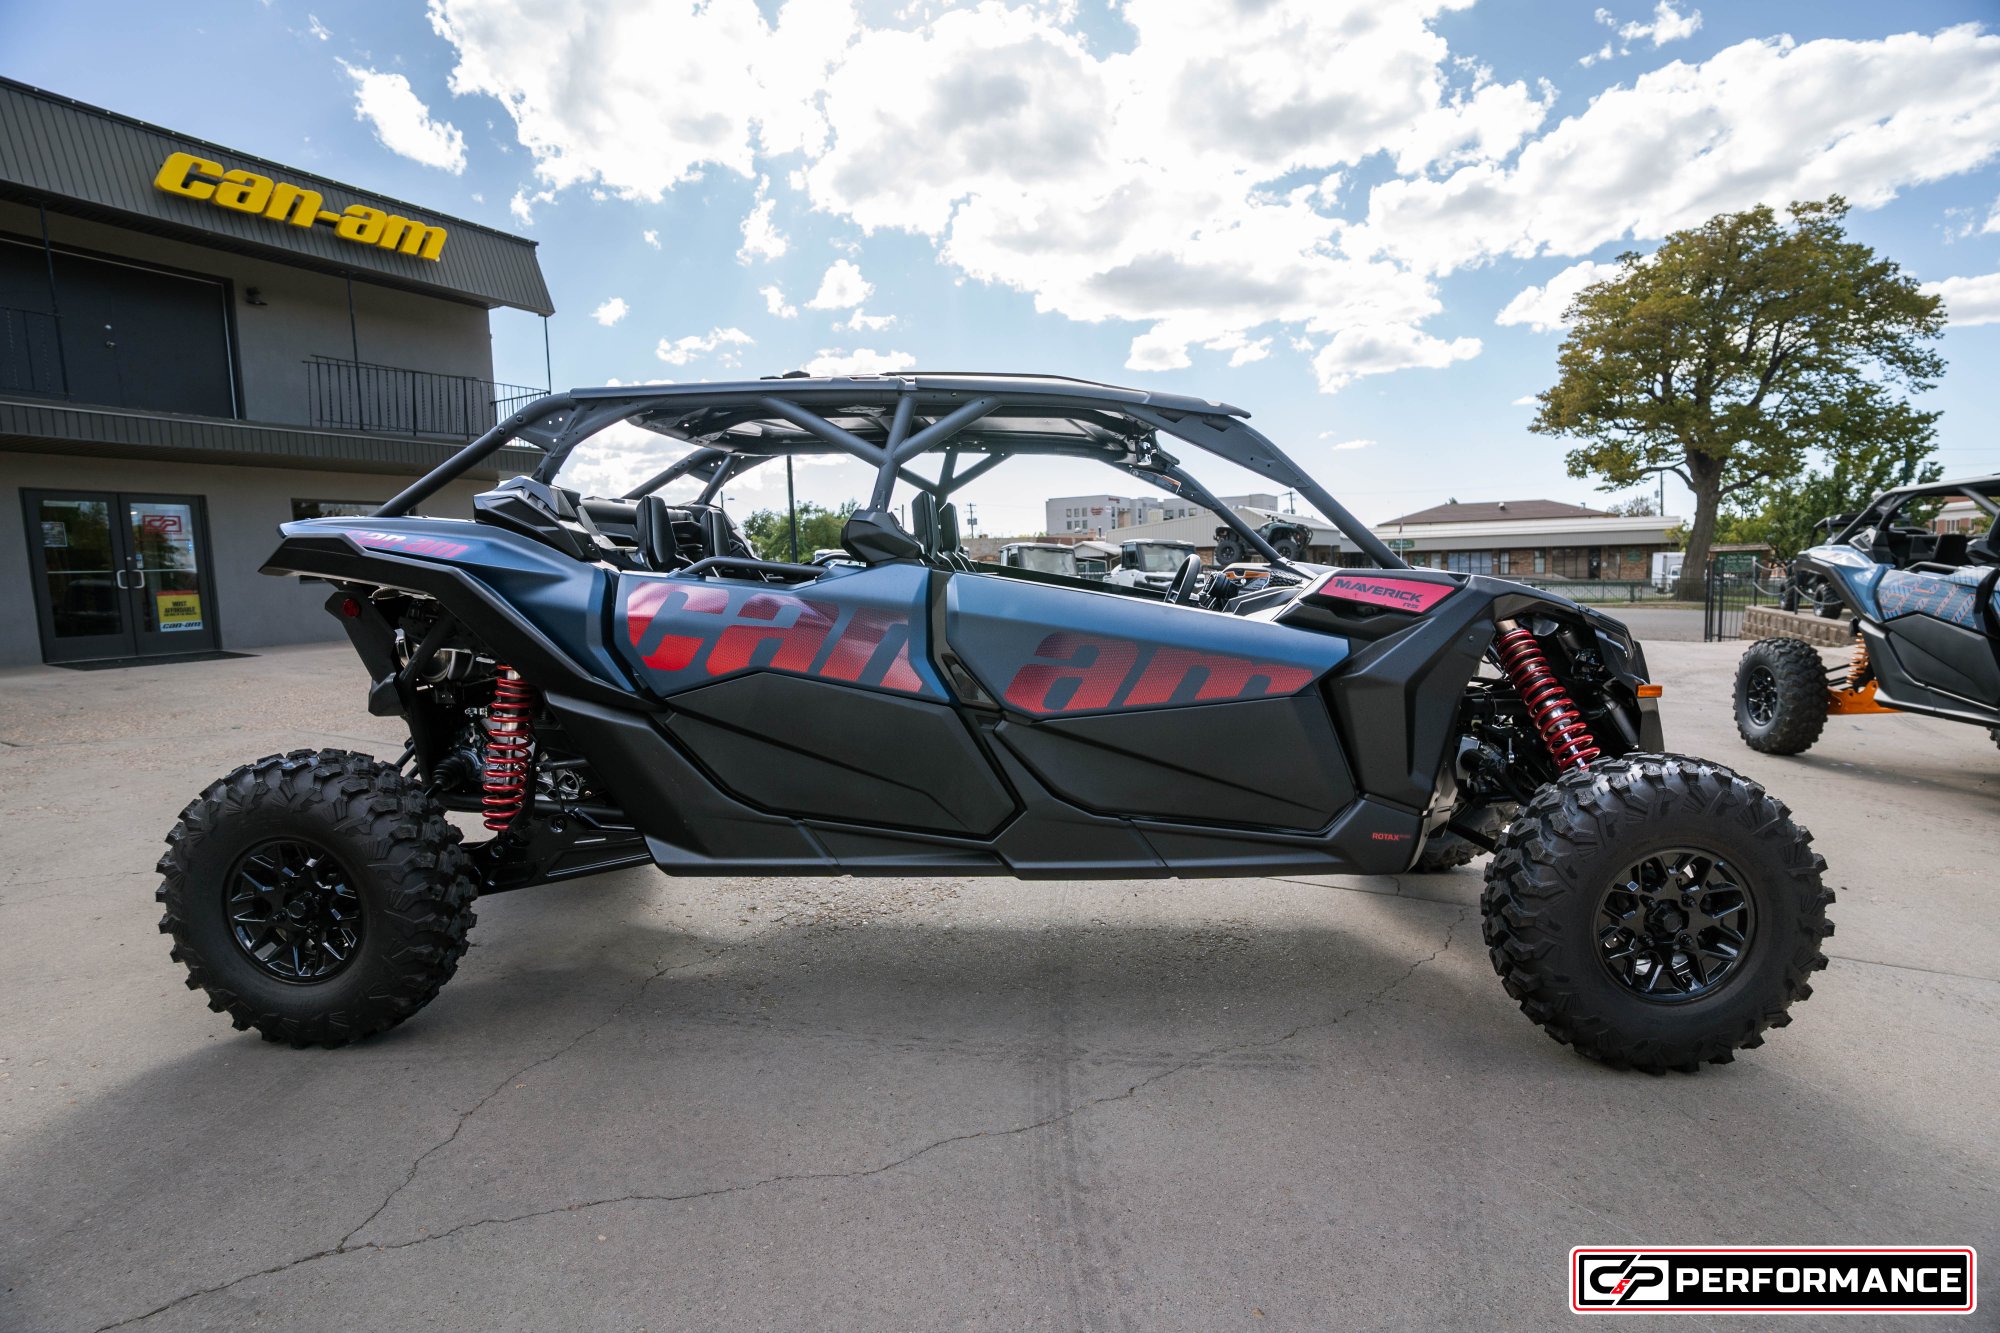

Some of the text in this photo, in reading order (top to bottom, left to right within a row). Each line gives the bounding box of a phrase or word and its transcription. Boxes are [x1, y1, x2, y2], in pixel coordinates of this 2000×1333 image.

[154, 151, 447, 261] can-am
[1335, 579, 1424, 603] MAVERICK
[162, 621, 201, 630] can-am
[1372, 832, 1399, 841] ROTAX
